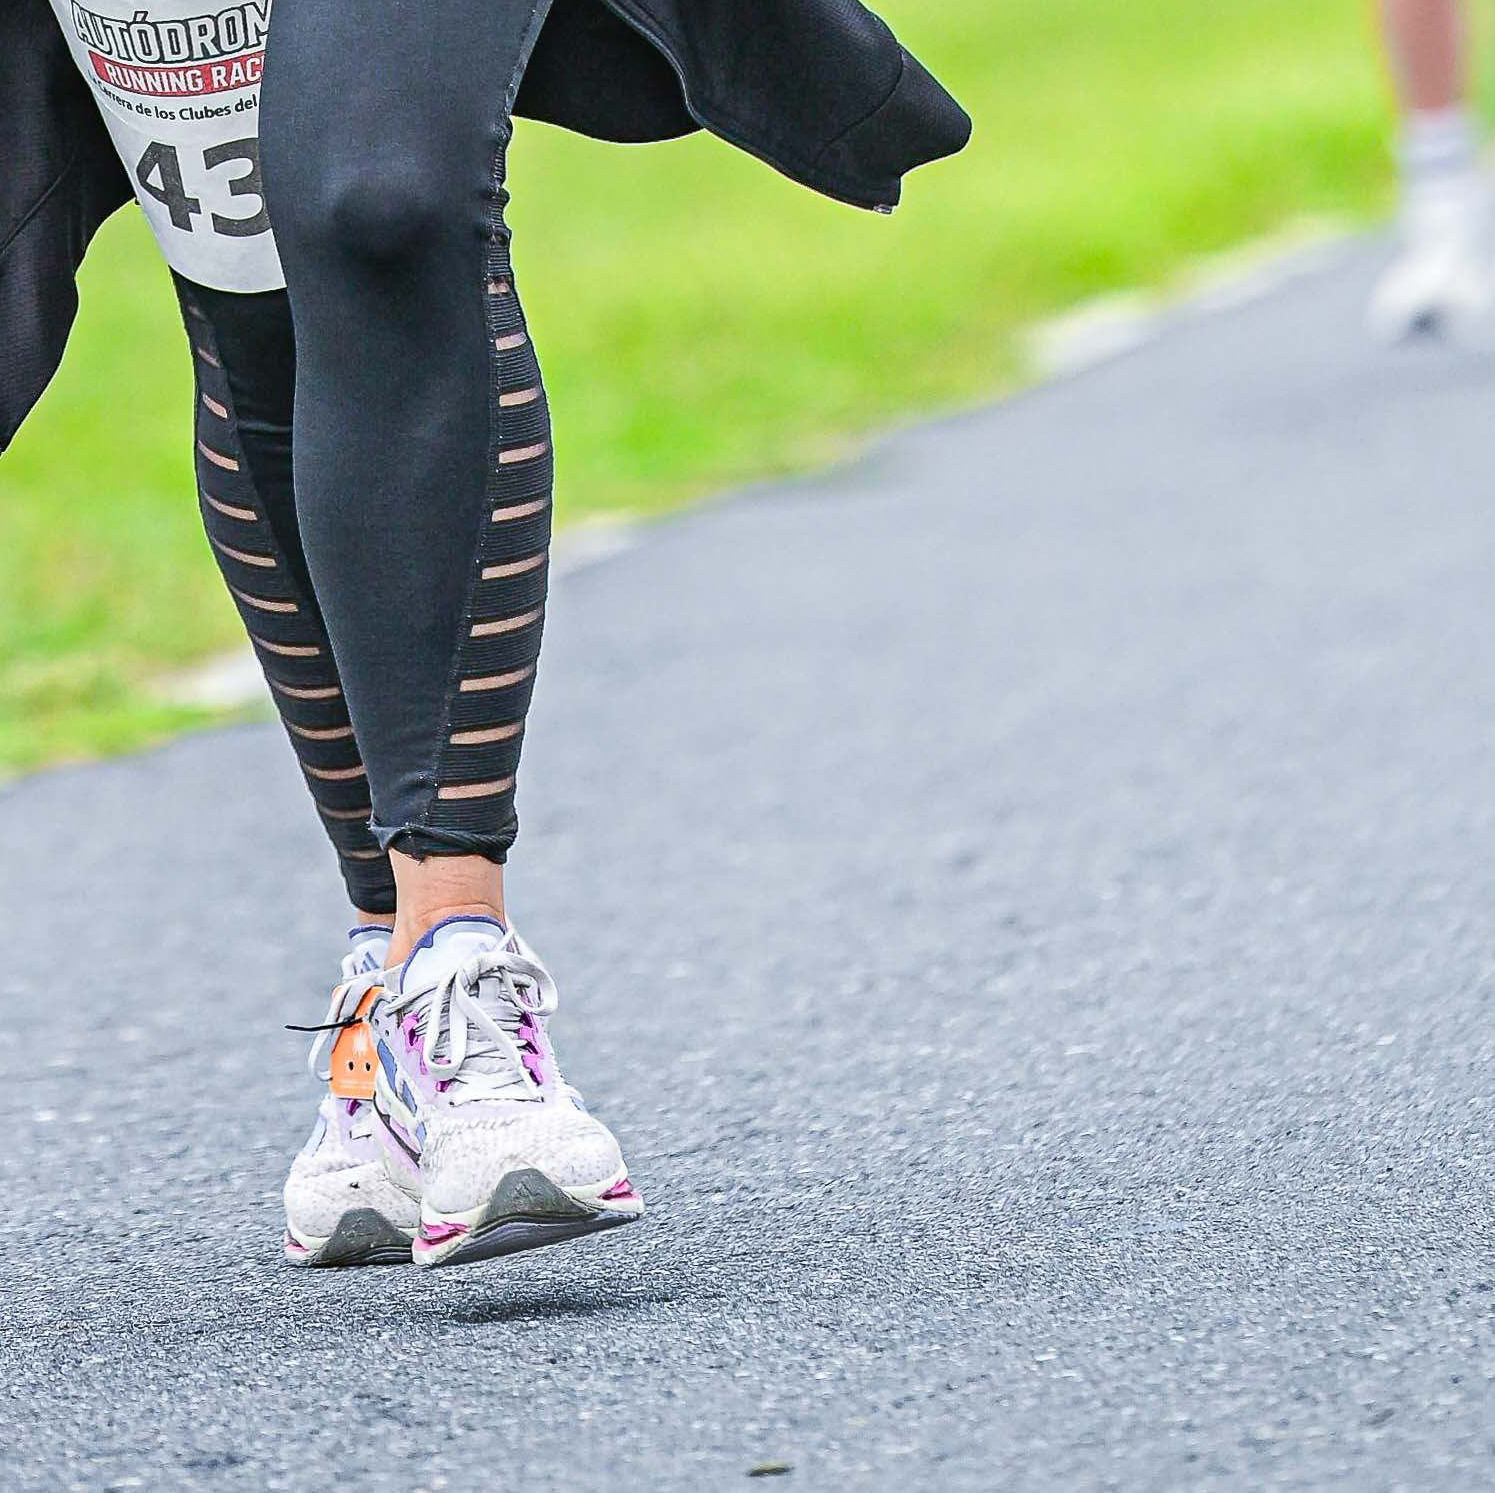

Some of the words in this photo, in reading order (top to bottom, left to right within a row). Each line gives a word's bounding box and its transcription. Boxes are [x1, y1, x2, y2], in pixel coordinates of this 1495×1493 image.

[105, 63, 203, 93] RUNNING
[211, 57, 264, 89] RAC
[135, 103, 152, 117] de
[155, 106, 175, 121] los
[179, 104, 232, 121] Clubes
[234, 94, 258, 113] del
